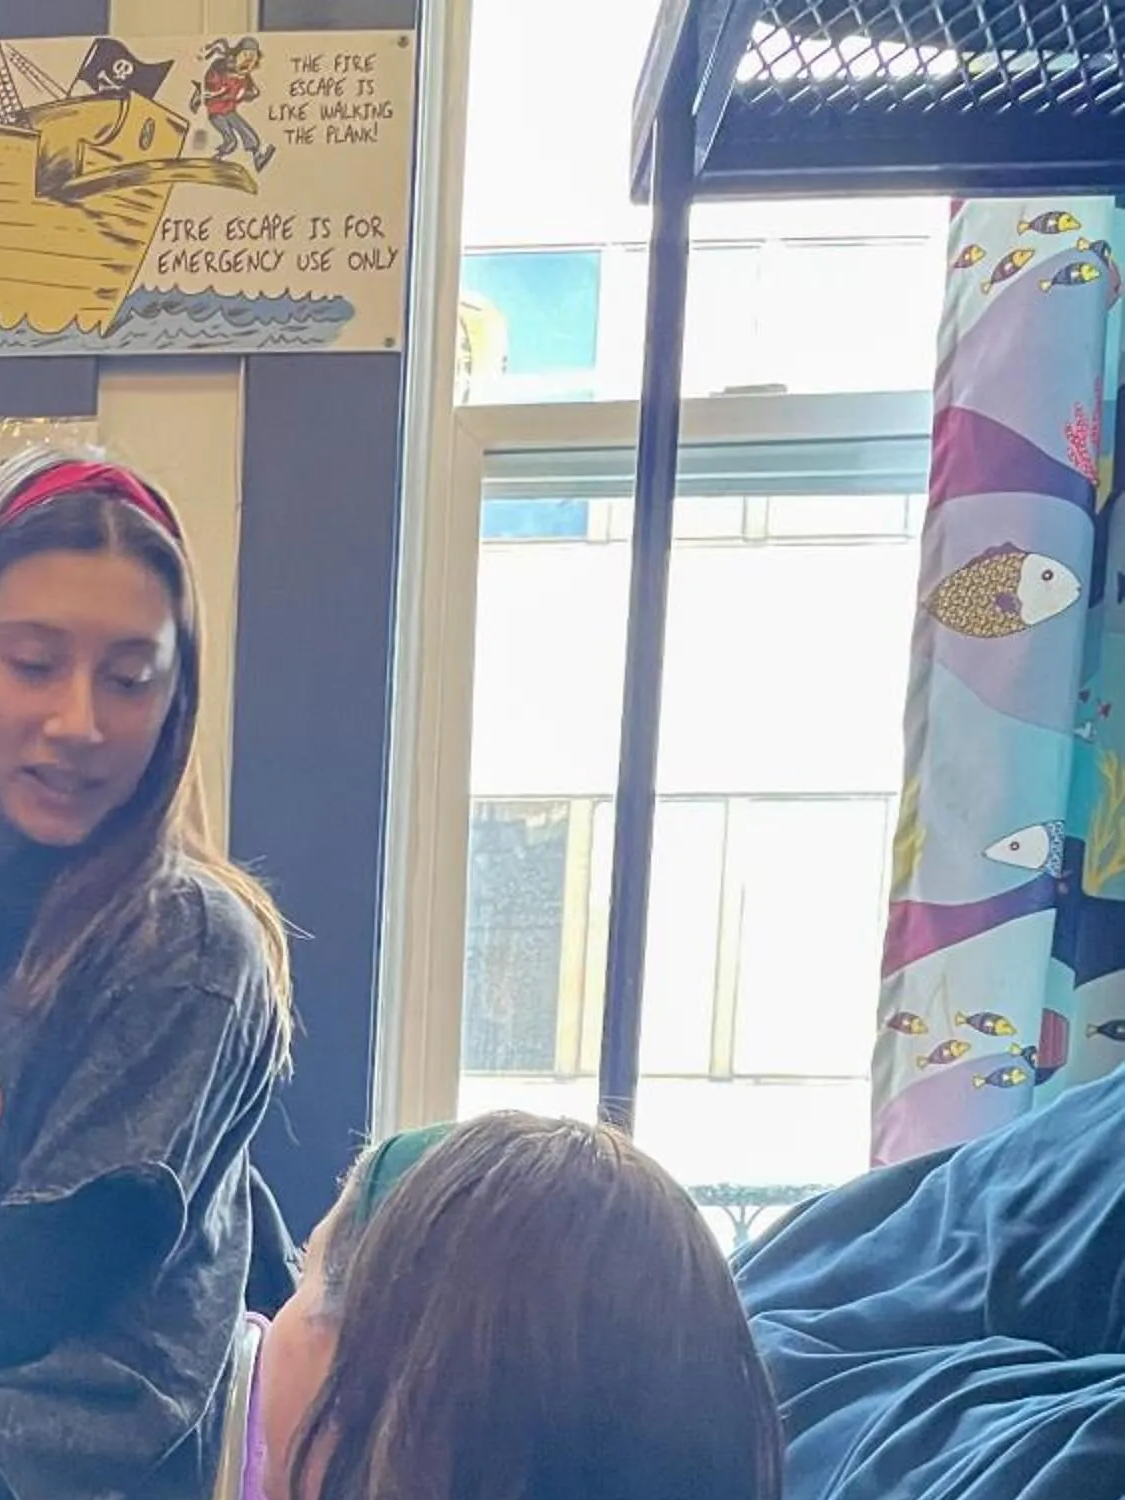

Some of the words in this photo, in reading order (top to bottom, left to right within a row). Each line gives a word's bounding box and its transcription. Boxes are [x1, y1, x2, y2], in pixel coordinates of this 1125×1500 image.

[290, 54, 324, 73] THE
[334, 53, 376, 73] FIRE
[289, 77, 346, 97] ESCAPE
[356, 79, 374, 96] IS
[268, 100, 312, 121] LIKE
[320, 100, 393, 121] WALKING
[283, 125, 316, 144] THE
[326, 121, 378, 144] PLANK!
[162, 216, 213, 242] FIRE
[226, 213, 296, 240] ESCAPE
[309, 216, 331, 241] IS
[344, 214, 385, 239] FOR
[157, 248, 284, 274] EMERGENCY
[297, 247, 335, 272] USE
[347, 246, 398, 271] ONLY
